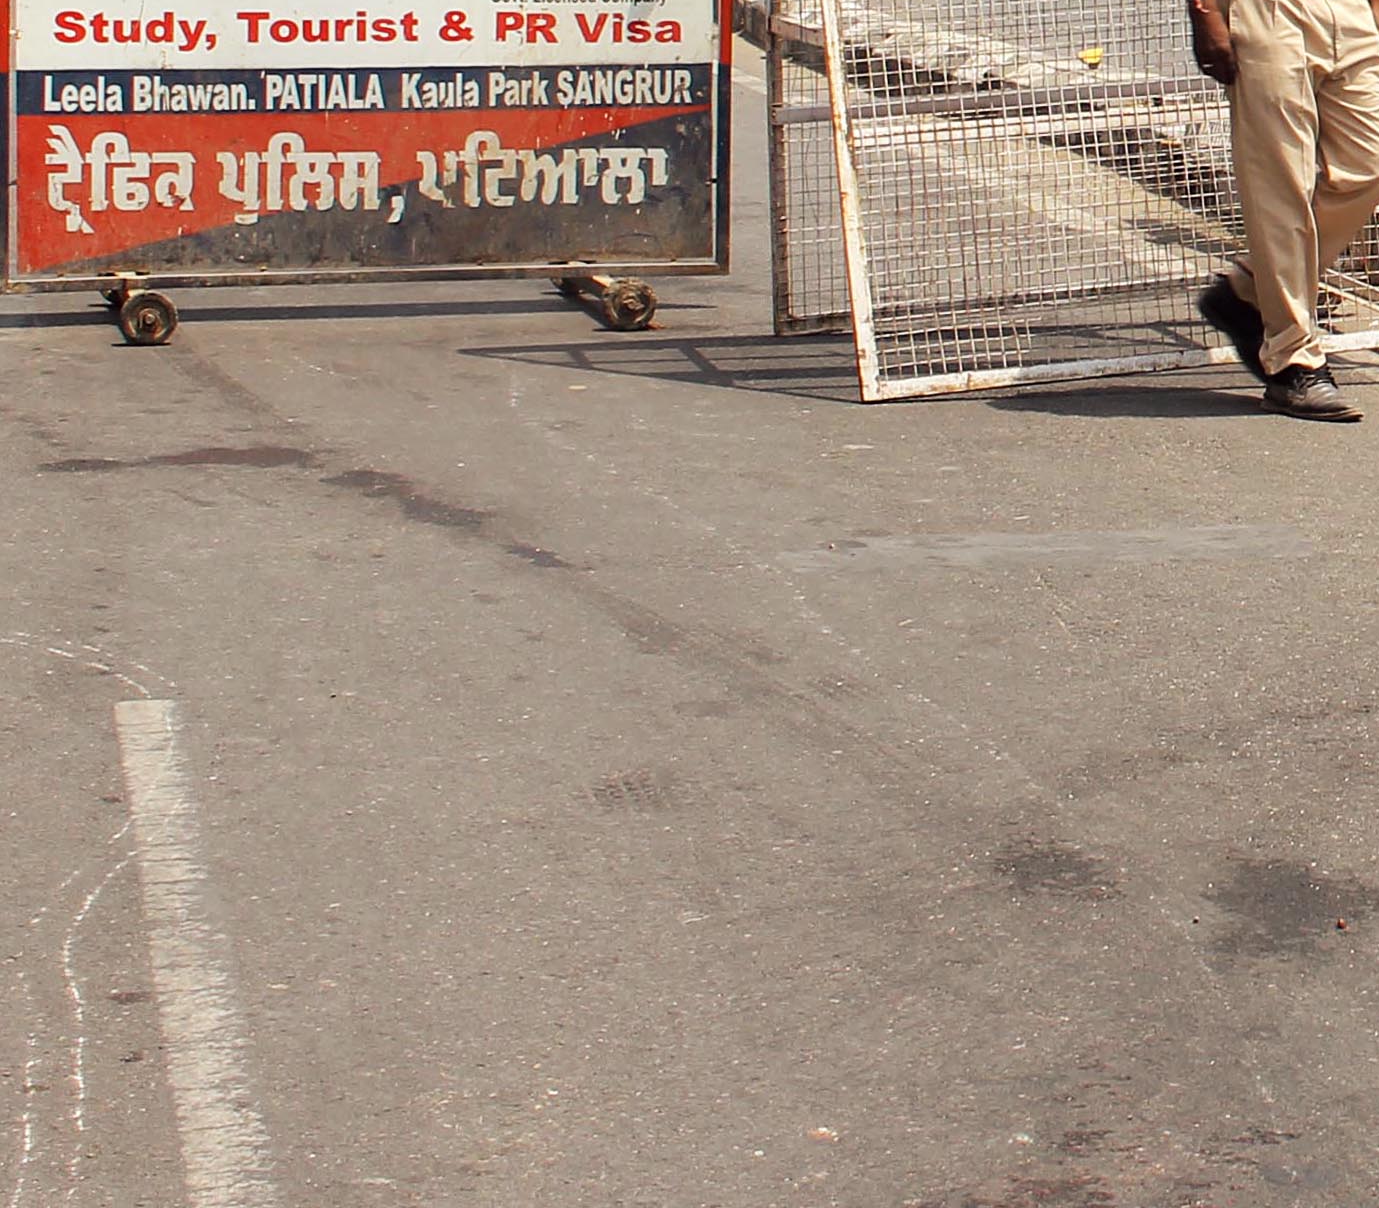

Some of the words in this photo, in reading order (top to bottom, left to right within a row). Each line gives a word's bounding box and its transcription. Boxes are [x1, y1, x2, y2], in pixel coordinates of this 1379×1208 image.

[54, 11, 218, 51] Study,
[237, 11, 420, 43] Tourist
[440, 12, 474, 42] &
[495, 12, 559, 43] PR
[576, 11, 684, 44] Visa
[44, 75, 123, 112] Leela
[265, 74, 385, 111] PATIALA
[402, 73, 480, 109] Kaula
[488, 71, 550, 108] Park
[556, 69, 693, 107] SANGRUR
[417, 130, 670, 208] ਪਟਿਆਲਾ
